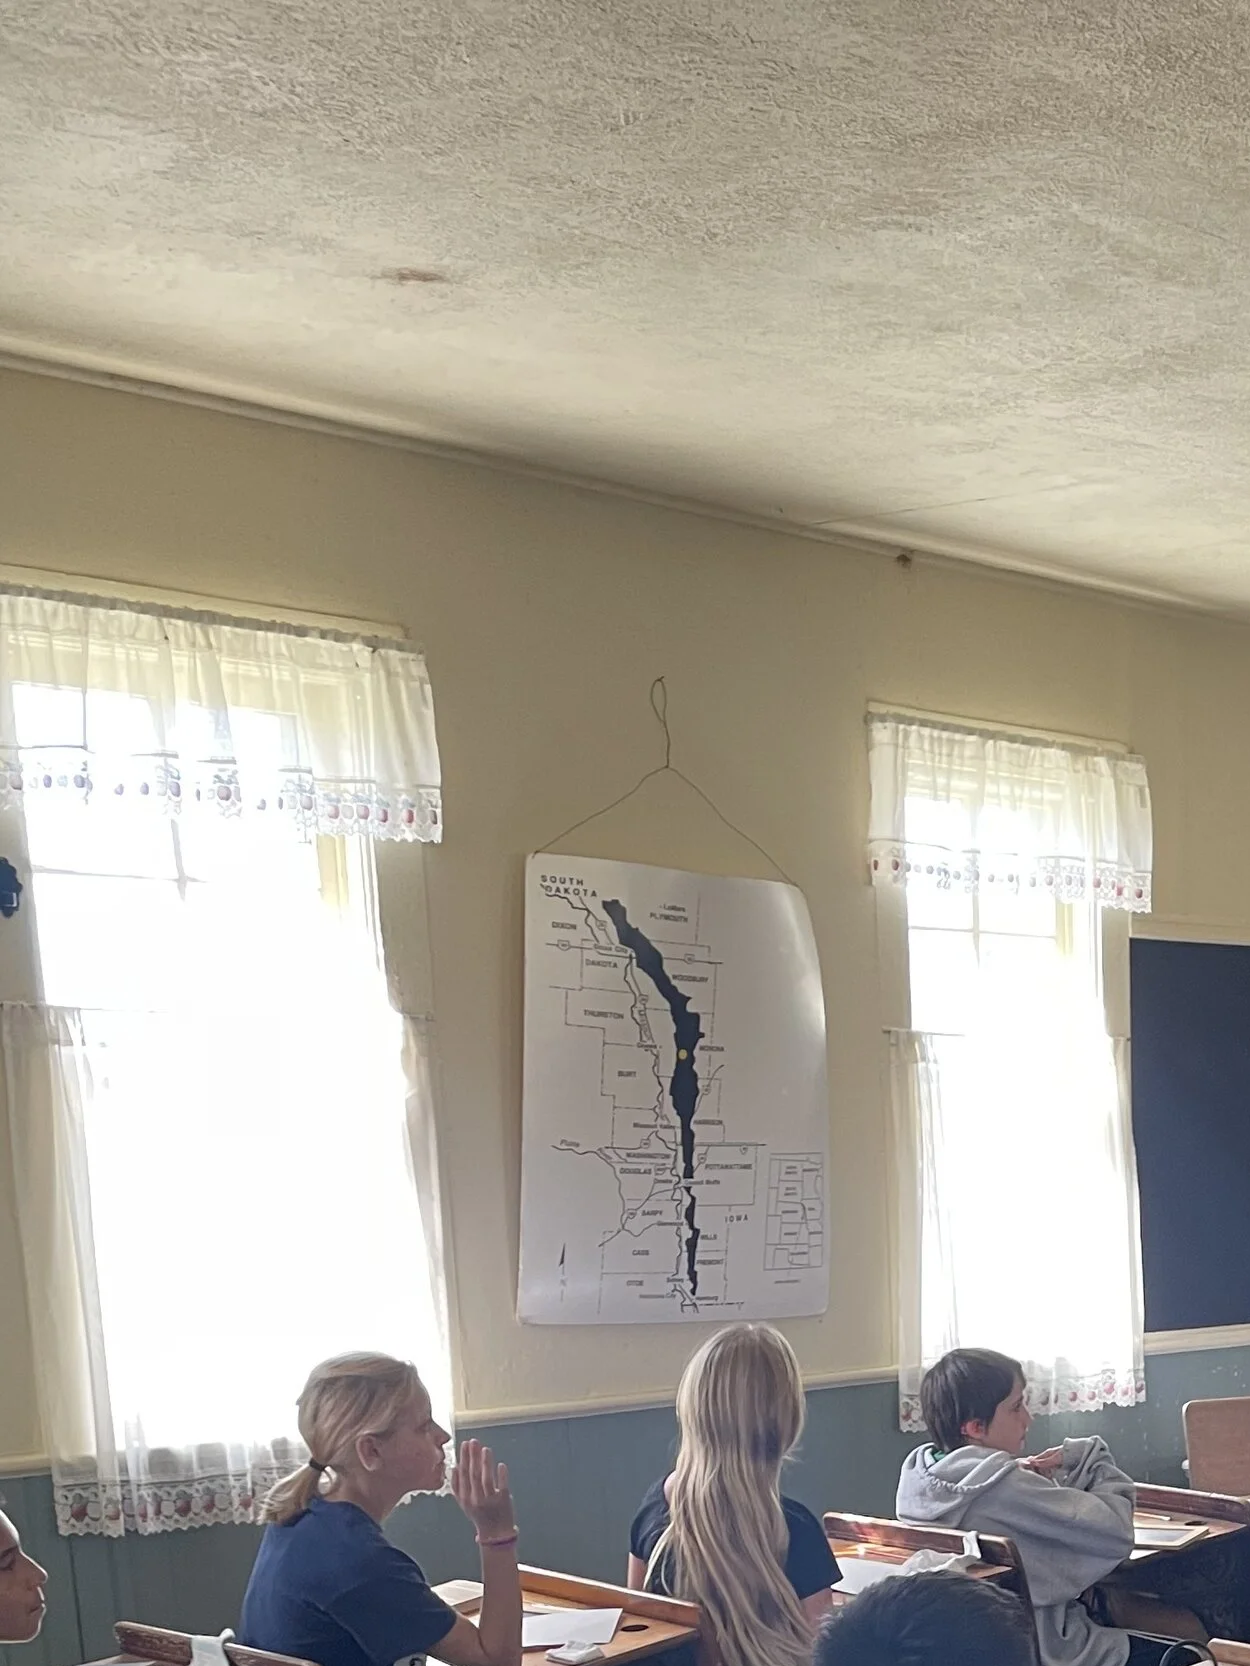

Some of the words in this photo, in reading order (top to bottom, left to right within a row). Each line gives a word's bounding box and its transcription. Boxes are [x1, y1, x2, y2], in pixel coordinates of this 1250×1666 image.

[540, 874, 584, 886] SOUTH
[544, 885, 598, 897] DAKOTA
[725, 1214, 749, 1224] IOWA
